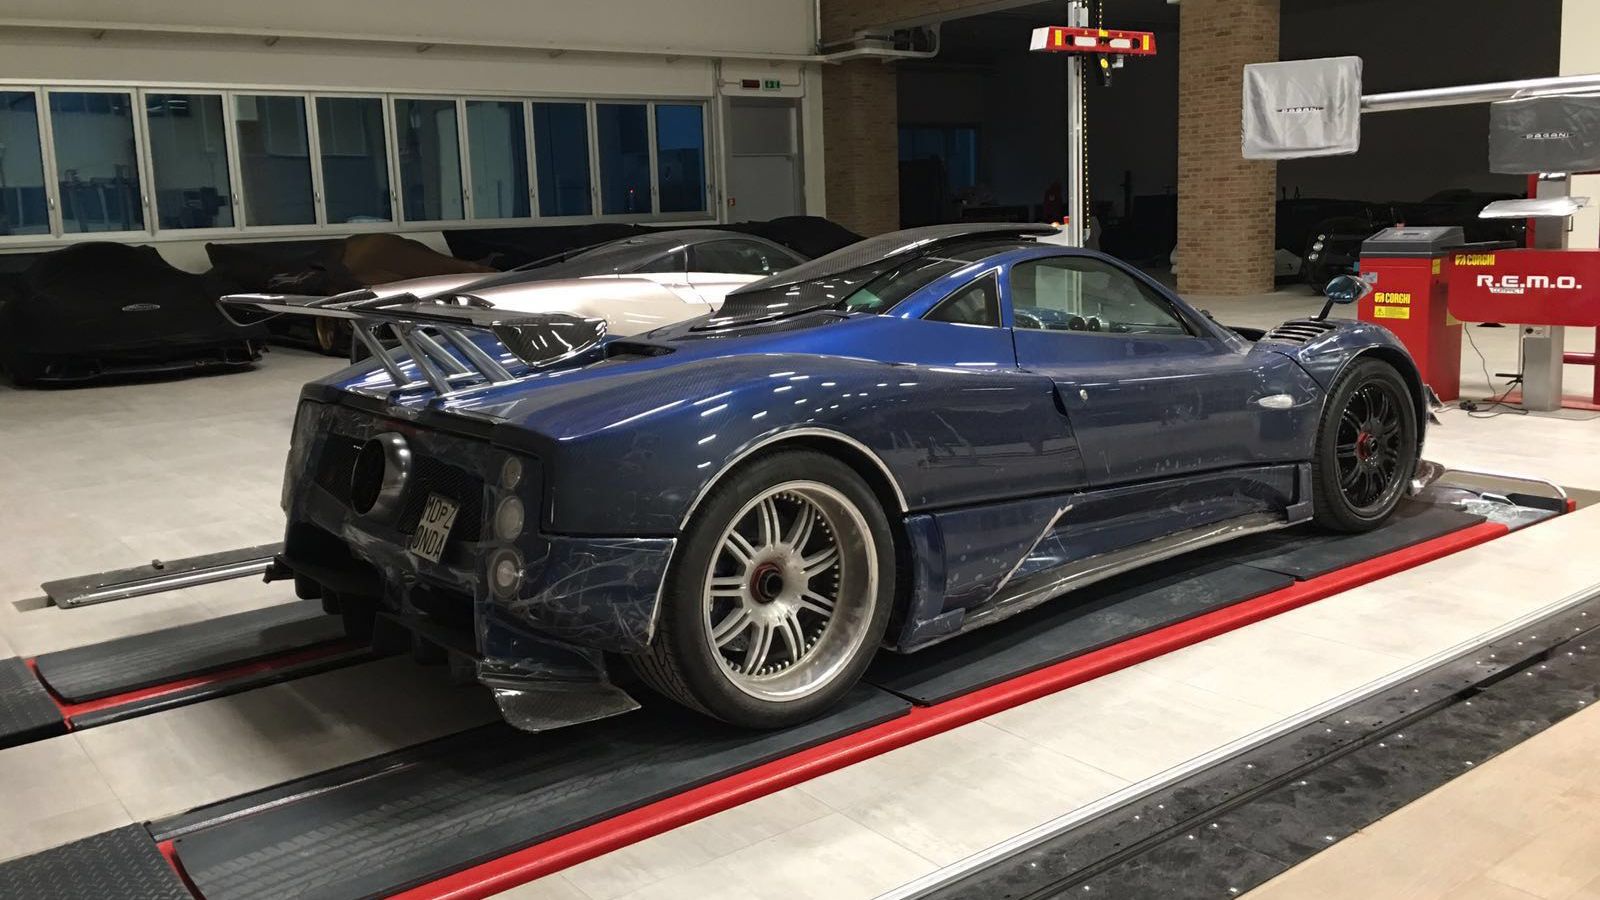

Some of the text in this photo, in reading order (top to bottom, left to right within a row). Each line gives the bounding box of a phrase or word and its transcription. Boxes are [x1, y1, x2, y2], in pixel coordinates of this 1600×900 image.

[1466, 254, 1496, 266] CORGHI
[1476, 274, 1582, 289] R.E.M.O.
[1385, 292, 1411, 304] CORGHI
[422, 496, 457, 530] MDPZ
[412, 524, 445, 559] ONDA
